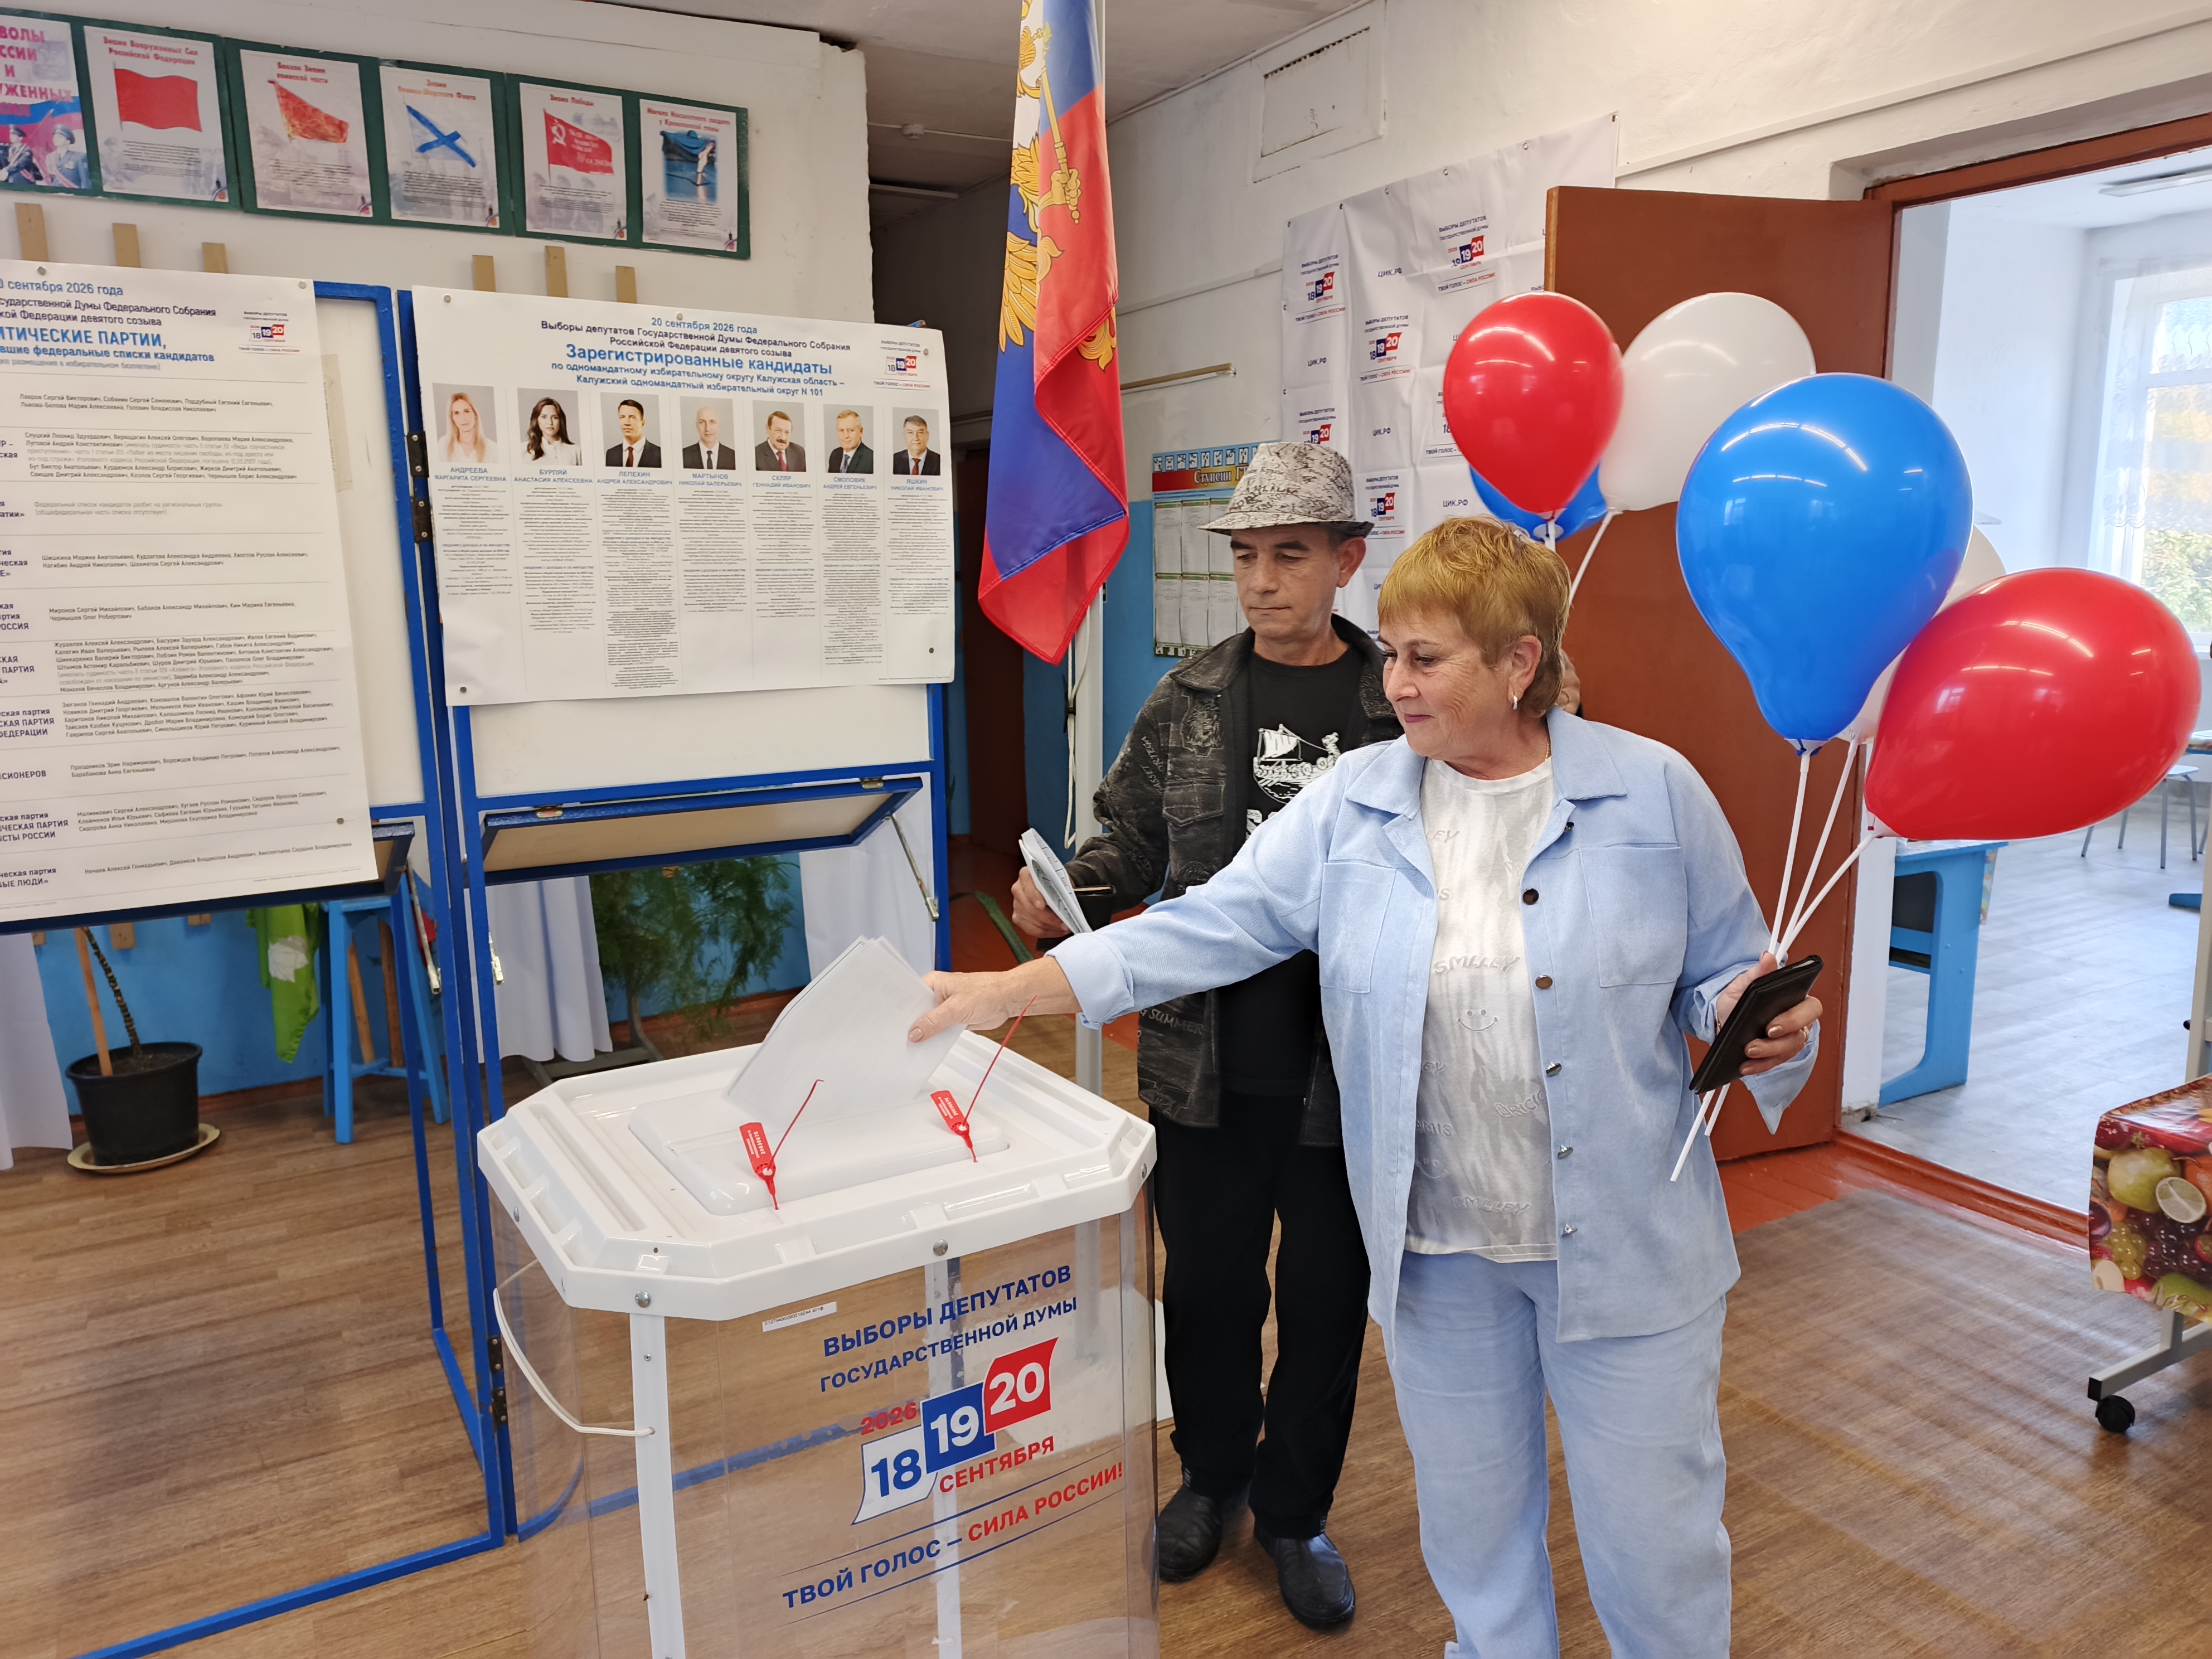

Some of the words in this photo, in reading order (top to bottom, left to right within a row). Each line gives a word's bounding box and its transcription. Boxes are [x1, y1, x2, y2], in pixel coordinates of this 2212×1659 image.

[0, 26, 45, 43] ВОЛЫ
[103, 36, 127, 47] Знамя
[4, 64, 15, 77] И
[1462, 249, 1471, 261] 19
[1472, 240, 1483, 253] 20
[8, 281, 62, 293] сентября
[66, 282, 94, 294] 2026
[98, 287, 123, 296] года
[1307, 291, 1315, 301] 18
[1316, 283, 1322, 294] 19
[1323, 276, 1332, 288] 20
[20, 311, 77, 322] Федерации
[81, 316, 123, 324] девятого
[74, 300, 101, 311] Думы
[103, 302, 171, 314] Федерального
[173, 305, 216, 317] Собрания
[541, 321, 583, 332] Выборы
[586, 326, 634, 335] депутатов
[638, 328, 715, 341] Государственной
[717, 334, 742, 343] Думы
[745, 337, 807, 348] Федерального
[809, 341, 850, 351] Собрания
[652, 317, 662, 326] 20
[665, 319, 710, 331] сентября
[713, 322, 734, 332] 2026
[737, 325, 758, 334] года
[98, 331, 166, 348] ПАРТИИ,
[610, 337, 664, 348] Российской
[668, 342, 716, 352] Федерации
[1370, 351, 1376, 360] 18
[1377, 343, 1385, 354] 19
[1386, 336, 1398, 347] 20
[33, 346, 110, 357] федеральные
[154, 352, 214, 362] кандидатов
[566, 344, 743, 368] Зарегистрированные
[749, 360, 831, 375] кандидаты
[566, 364, 647, 376] одномандатному
[651, 368, 724, 381] избирательному
[726, 374, 754, 382] округу
[757, 374, 801, 384] Калужская
[803, 377, 837, 386] область
[577, 375, 628, 385] Калужский
[630, 380, 704, 389] одномандатный
[707, 383, 774, 393] избирательный
[777, 388, 799, 396] округ
[1312, 434, 1319, 444] 19
[1320, 427, 1329, 438] 20
[1194, 470, 1231, 487] Ступени
[1371, 508, 1377, 517] 18
[1378, 502, 1385, 512] 19
[1385, 496, 1394, 507] 20
[22, 717, 54, 726] ПАРТИЯ
[36, 819, 69, 829] ПАРТИЯ
[22, 831, 56, 840] РОССИИ
[17, 878, 48, 886] ЛЮДИ»
[1149, 1008, 1203, 1035] SUMMER
[823, 1307, 933, 1357] ВЫБОРЫ
[939, 1264, 1072, 1325] ДЕПУТАТОВ
[820, 1314, 1018, 1392] ГОСУДАРСТВЕННОЙ
[1022, 1297, 1078, 1328] ДУМЫ
[989, 1362, 1045, 1415] 20
[861, 1402, 918, 1435] 2026
[930, 1405, 979, 1454] 19
[871, 1449, 923, 1498] 18
[939, 1436, 1055, 1493] СЕНТЯБРЯ
[783, 1570, 853, 1609] ТВОЙ
[860, 1540, 941, 1583] ГОЛОС
[968, 1505, 1029, 1542] СИЛА
[1035, 1462, 1124, 1515] РОССИИ!
